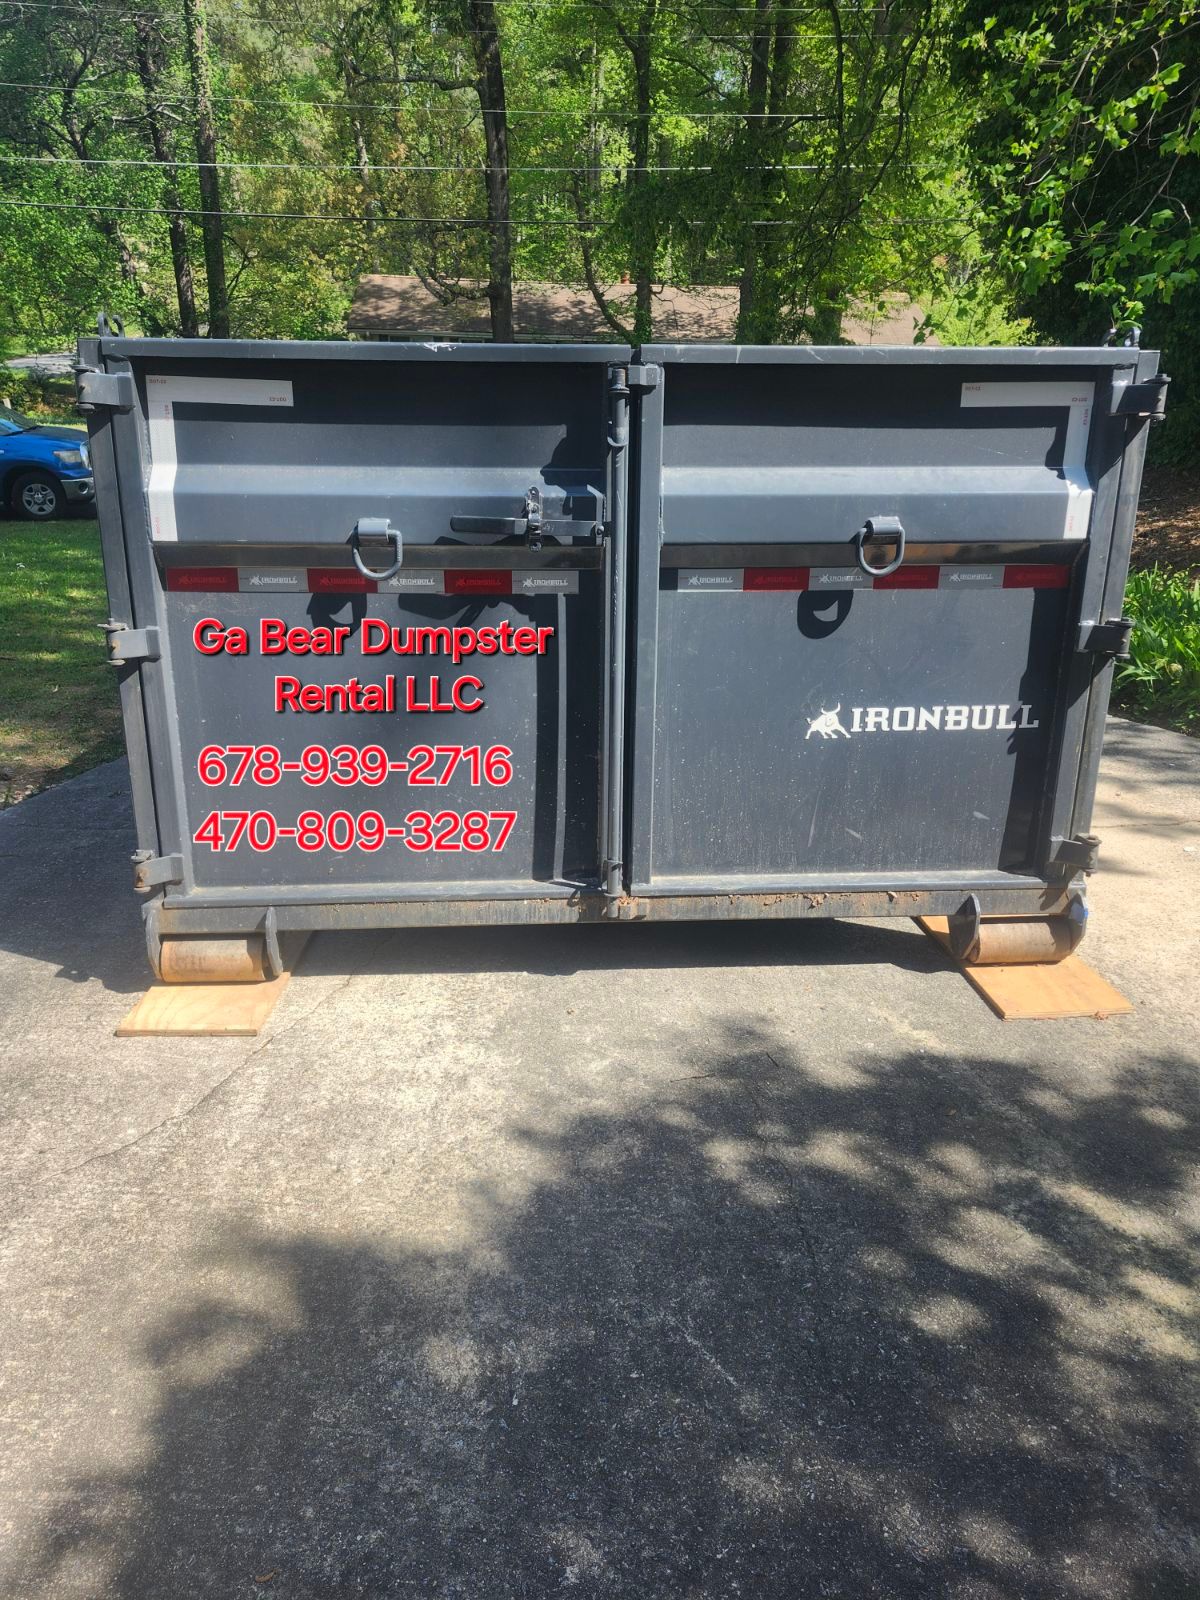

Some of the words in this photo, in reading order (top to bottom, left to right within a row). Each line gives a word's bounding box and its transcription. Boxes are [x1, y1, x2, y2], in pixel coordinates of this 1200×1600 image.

[399, 577, 436, 586] IRONBULL
[533, 577, 569, 586] IRONBULL
[850, 704, 1040, 733] IRONBULL
